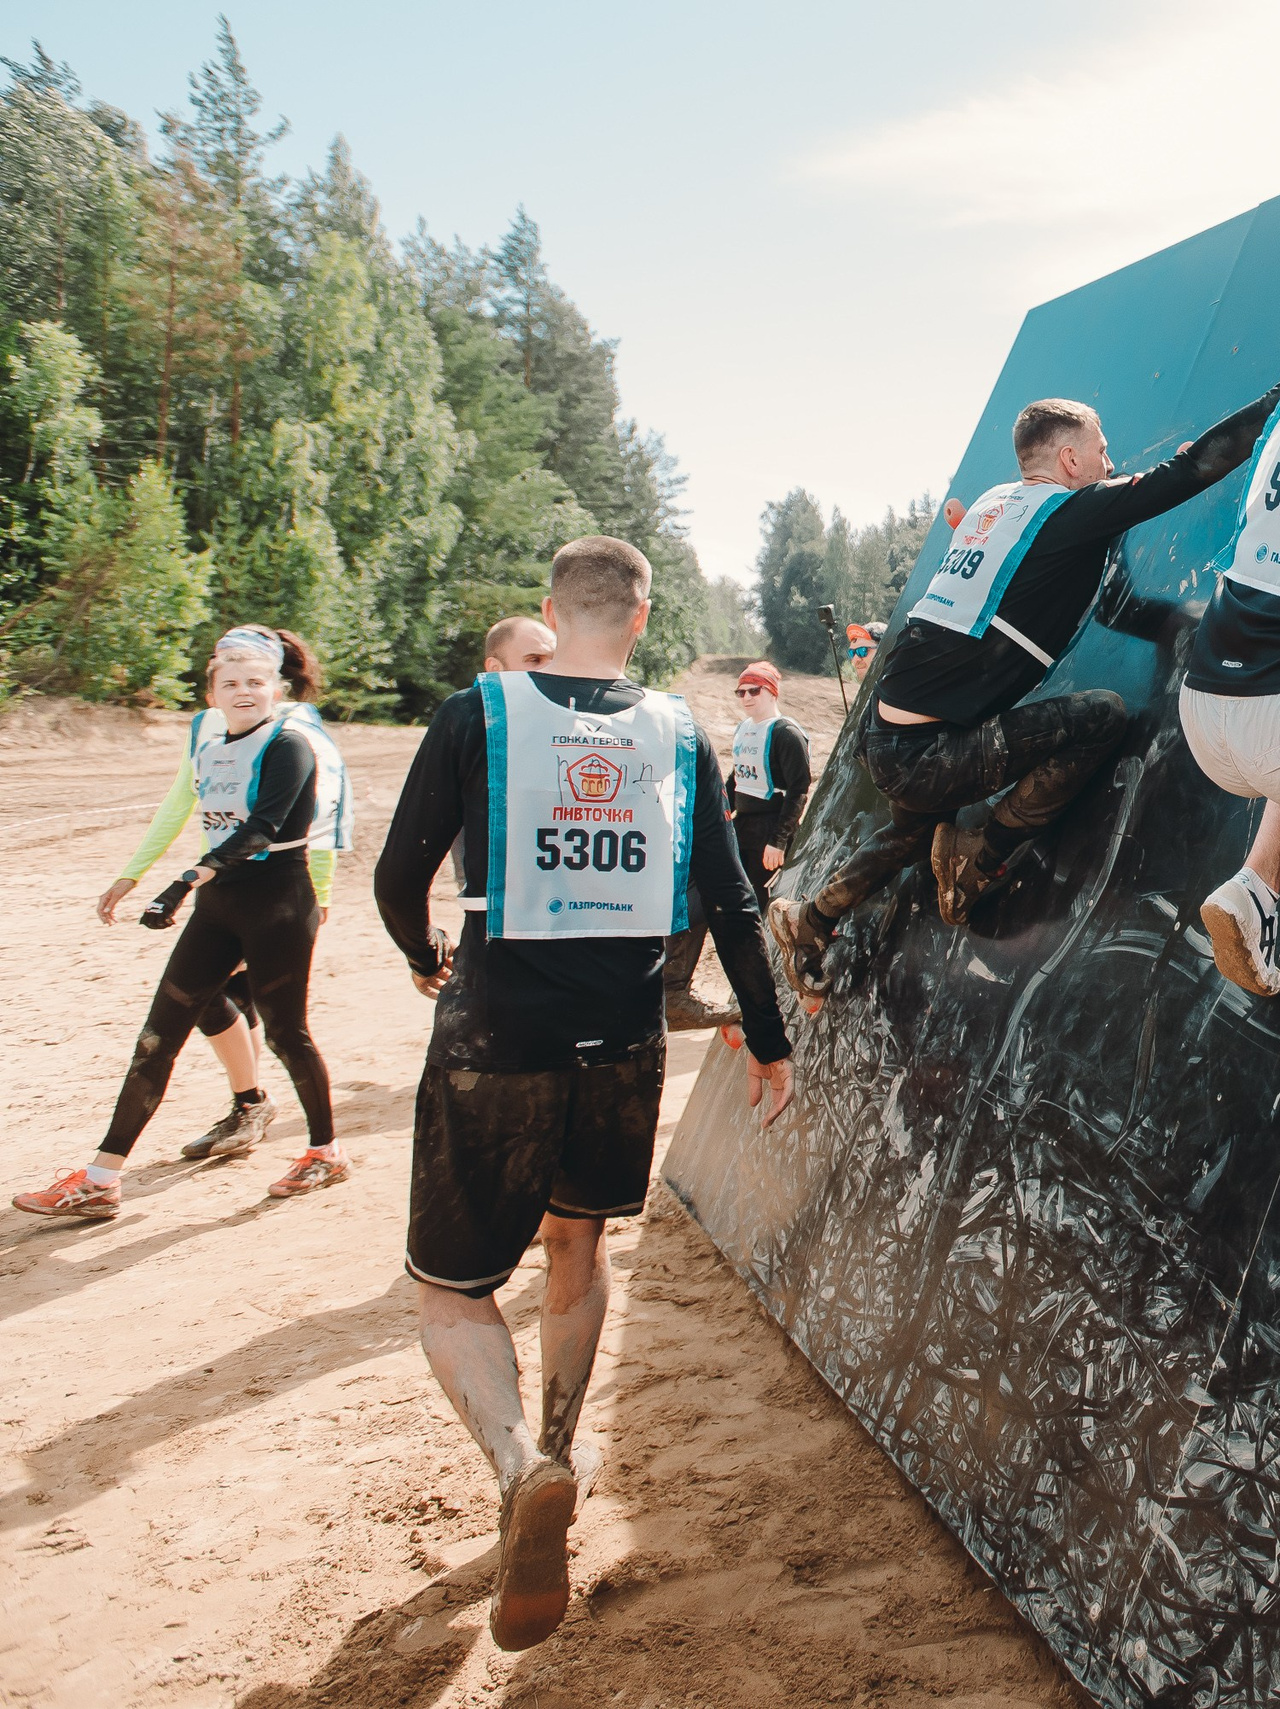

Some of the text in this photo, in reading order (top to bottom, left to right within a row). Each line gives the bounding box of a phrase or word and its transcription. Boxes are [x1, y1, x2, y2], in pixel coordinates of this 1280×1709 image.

[552, 735, 634, 746] ГОНКА ГЕРОЕВ
[536, 827, 648, 873] 5306
[568, 901, 634, 912] ГАЗПРОМБАНК
